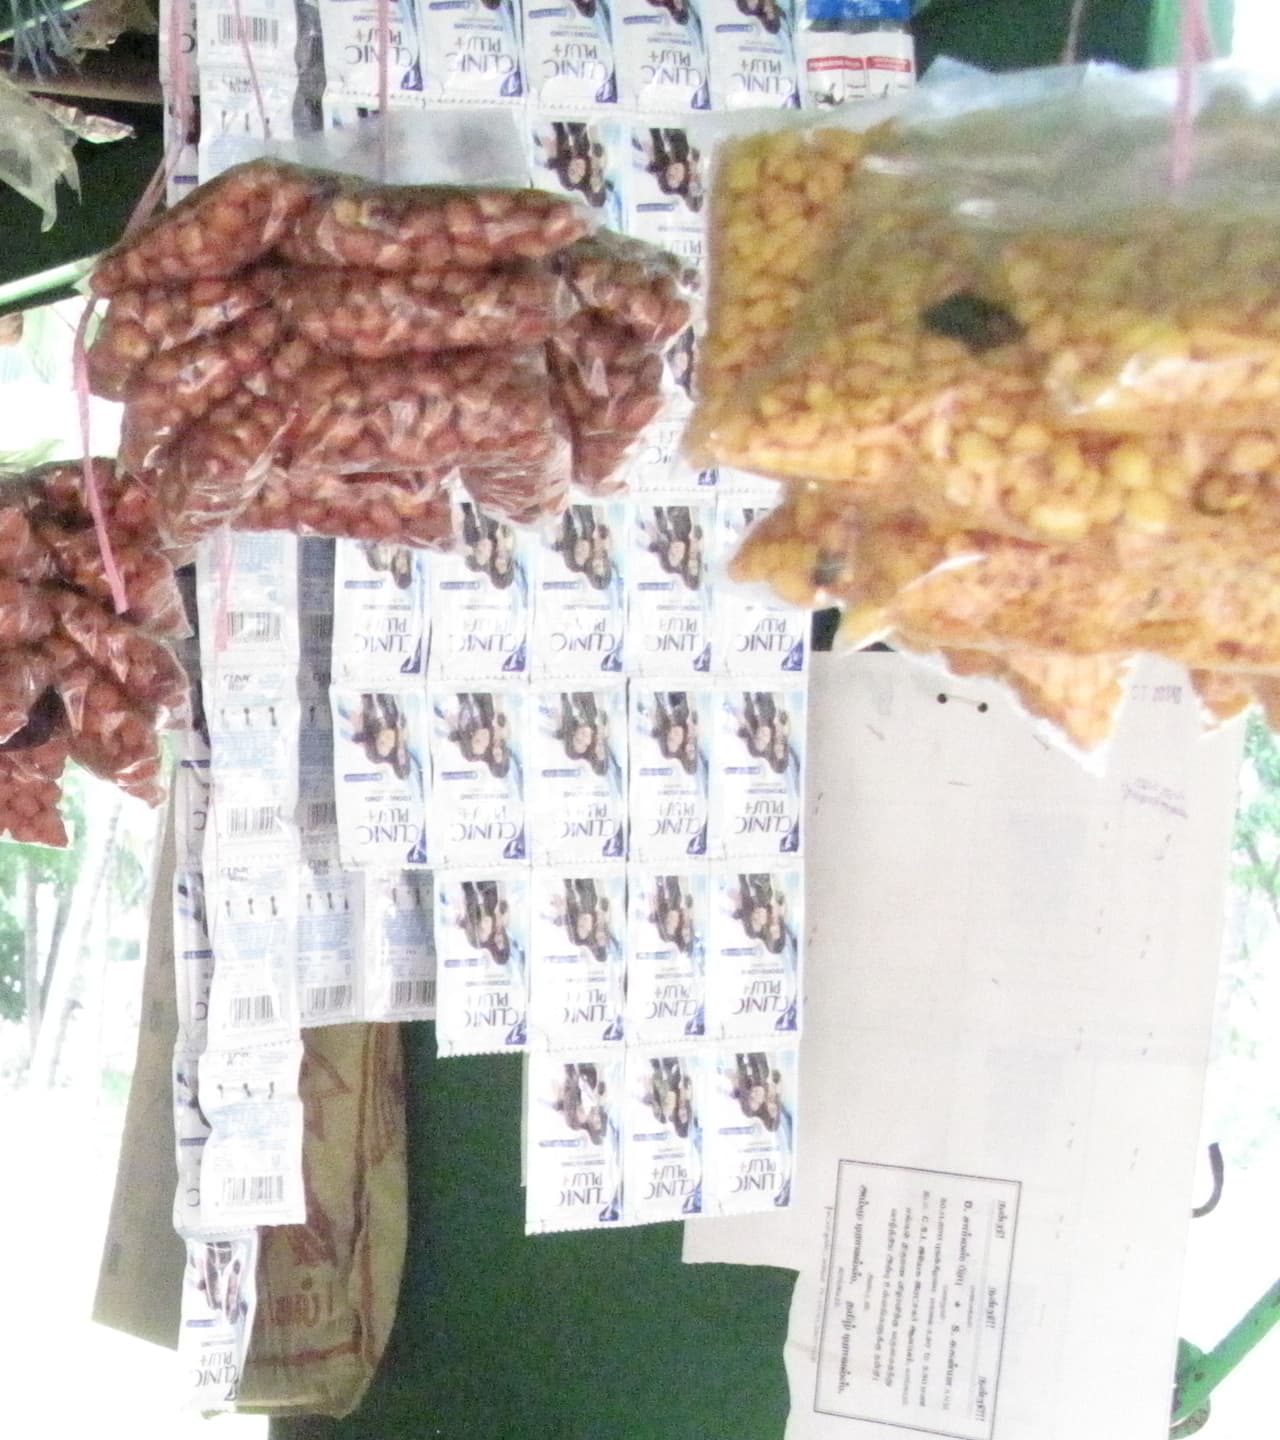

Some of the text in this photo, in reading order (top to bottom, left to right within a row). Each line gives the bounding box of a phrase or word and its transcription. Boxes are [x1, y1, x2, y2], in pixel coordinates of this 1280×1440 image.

[345, 44, 414, 67] CLNIC
[445, 52, 514, 74] CLINIC
[543, 60, 609, 82] CLINIC
[640, 65, 704, 87] CLINIC
[730, 73, 795, 94] CLINIC
[551, 632, 617, 651] CLINIC
[736, 633, 796, 652] CLINIC
[355, 824, 420, 845] CLINIC
[734, 815, 796, 835] CLINIC
[645, 999, 699, 1019] CLINIC
[731, 995, 792, 1016] CLINIC
[643, 1178, 697, 1200] CLINIC
[729, 1172, 786, 1194] CLINIC
